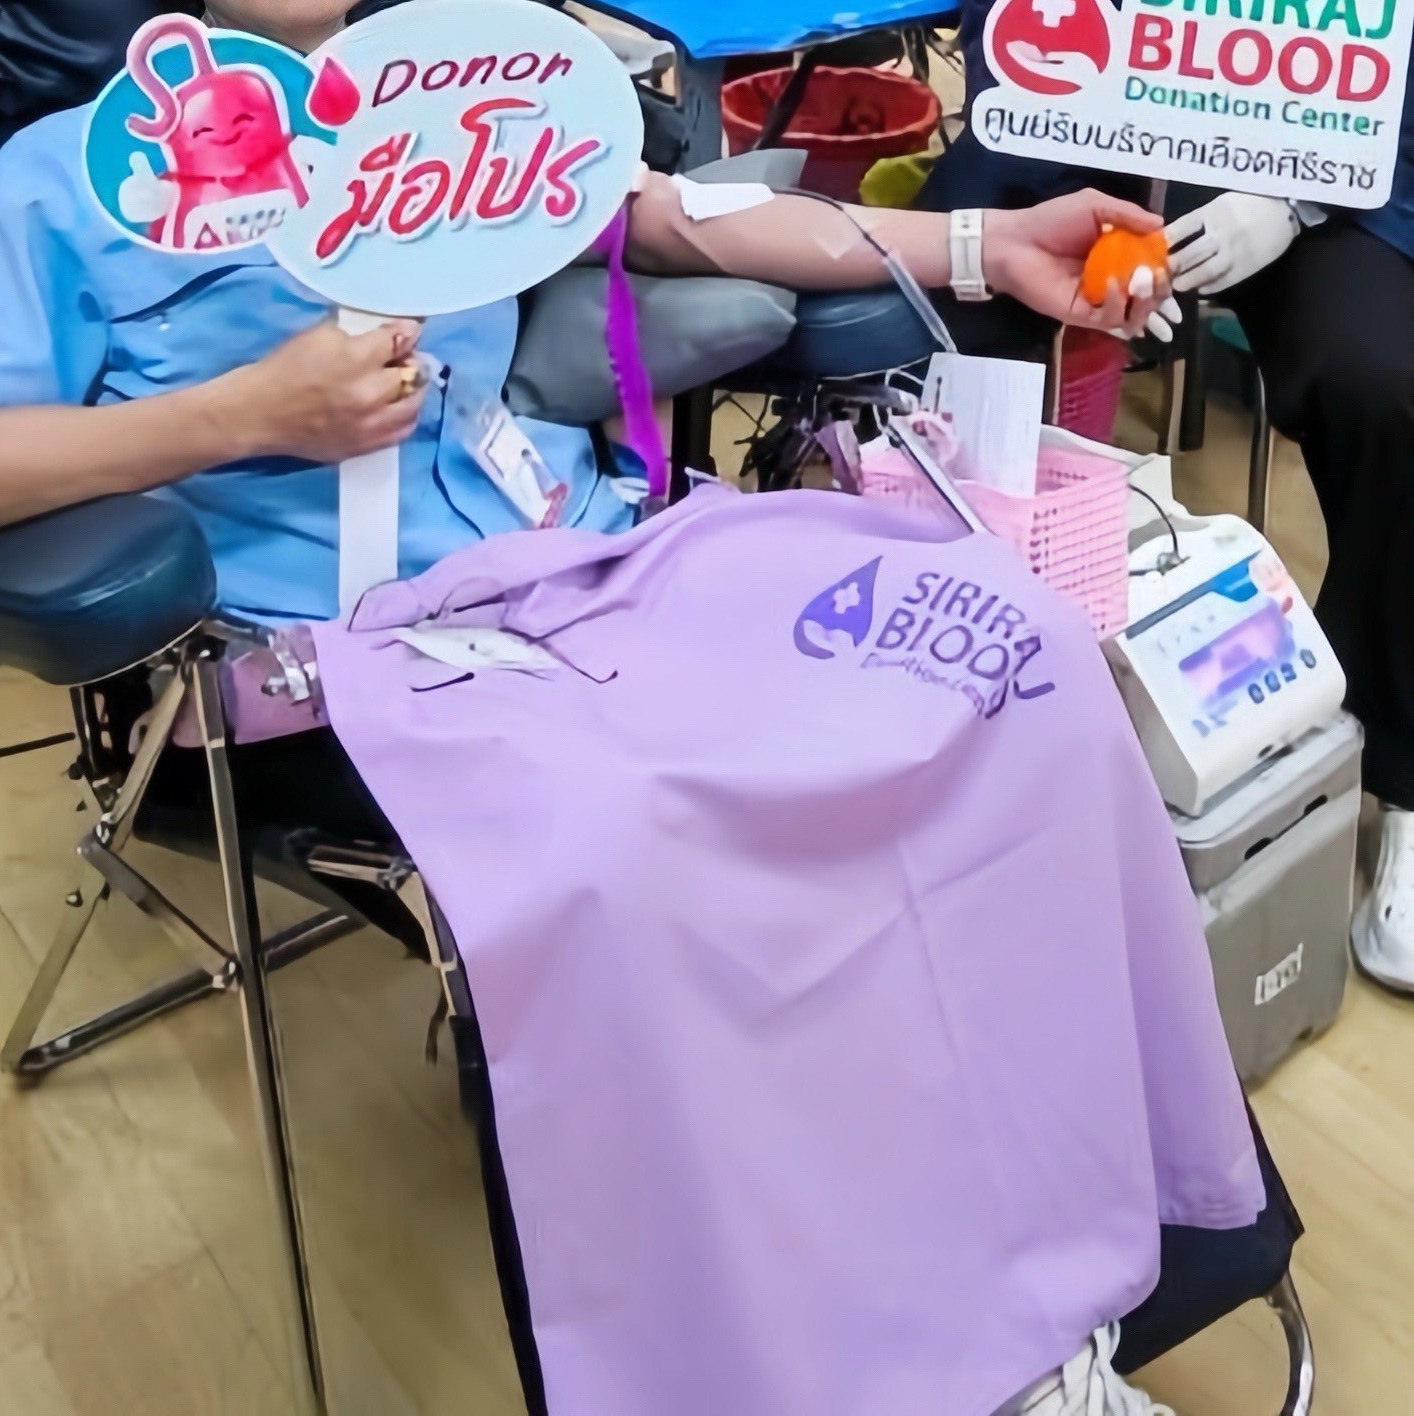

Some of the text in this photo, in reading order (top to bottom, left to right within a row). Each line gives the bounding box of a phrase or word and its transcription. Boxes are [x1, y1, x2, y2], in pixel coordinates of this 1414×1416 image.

[370, 50, 574, 108] Donor
[1127, 13, 1391, 102] BLOOD
[1124, 75, 1386, 137] Donation Center
[314, 97, 603, 260] มือโปร
